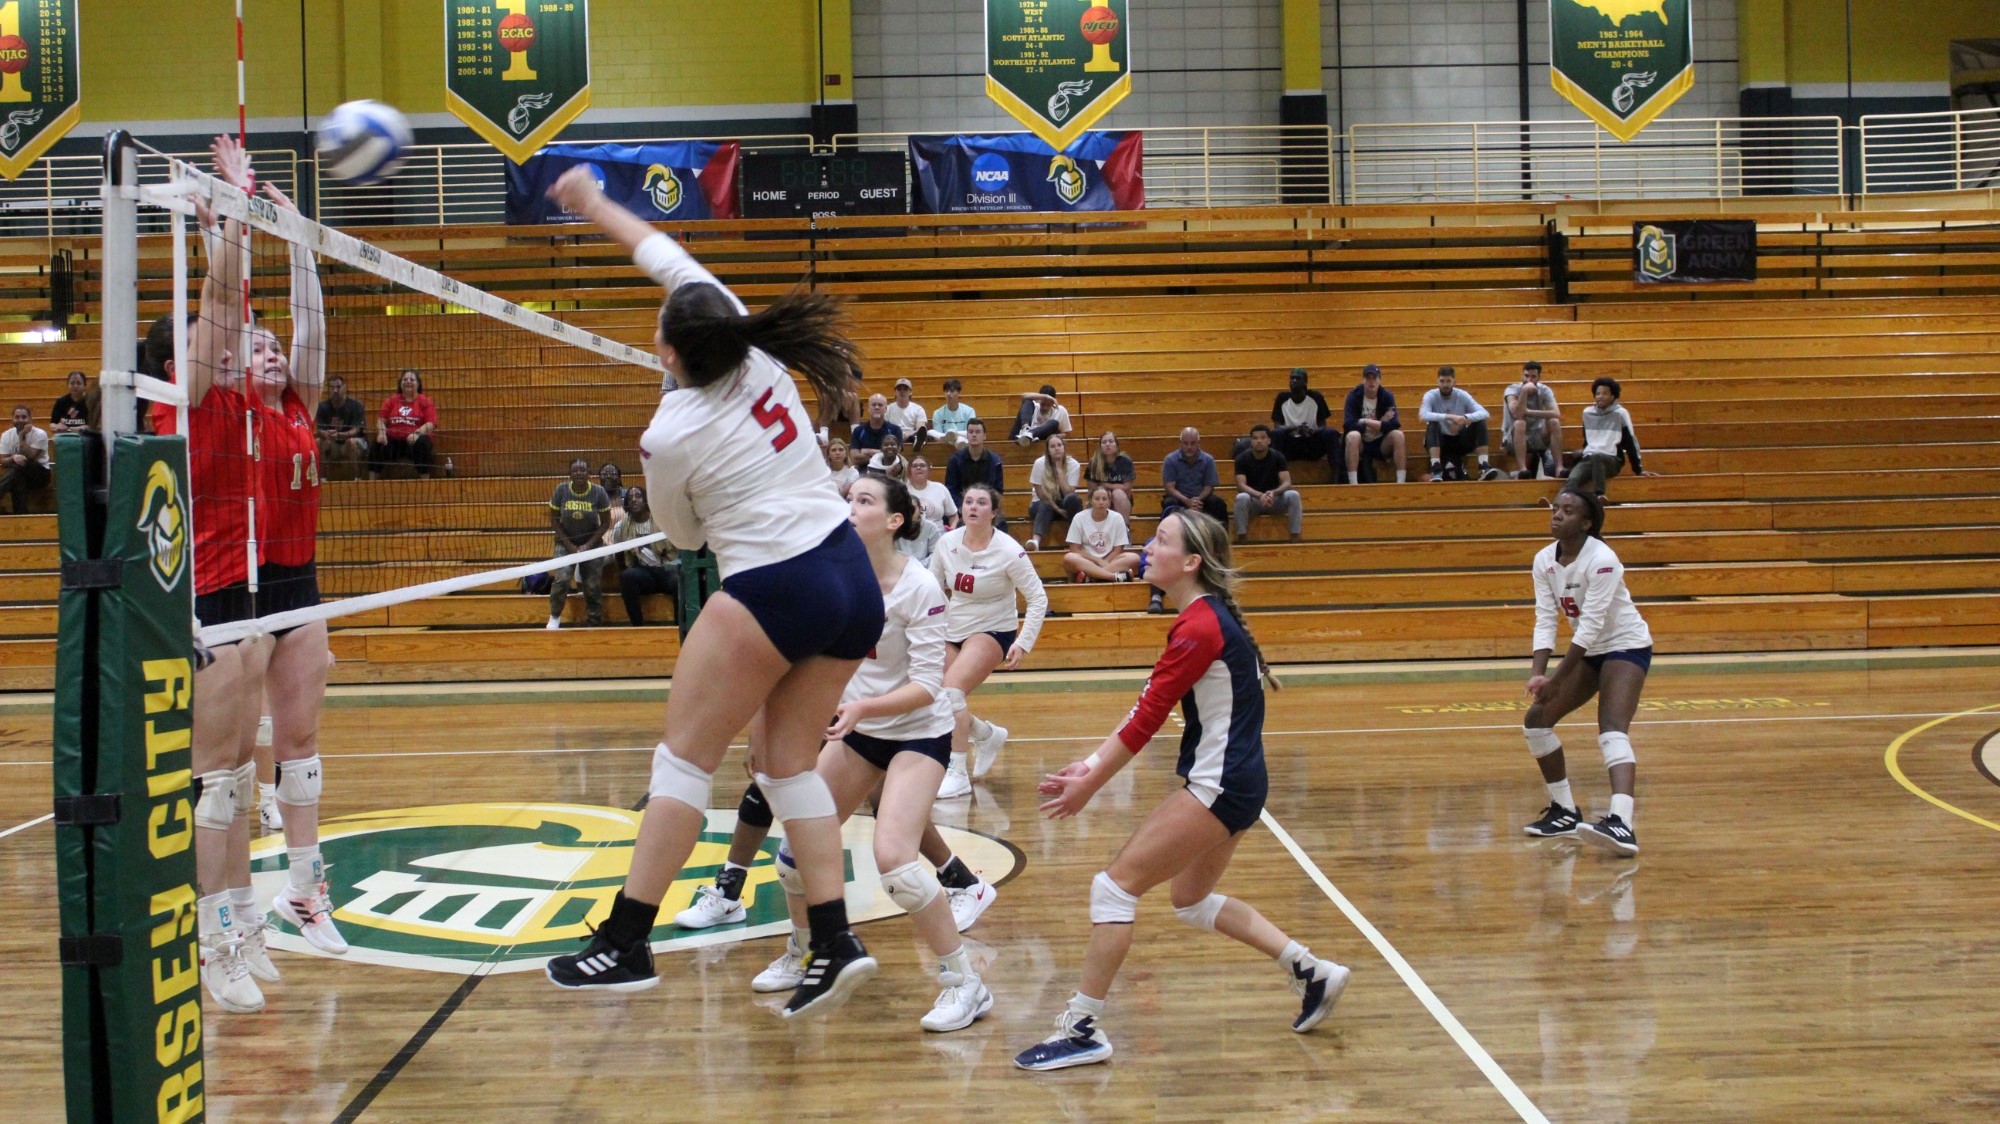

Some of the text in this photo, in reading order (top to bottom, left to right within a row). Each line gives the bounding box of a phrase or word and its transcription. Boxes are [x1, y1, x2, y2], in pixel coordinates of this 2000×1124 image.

[1082, 20, 1118, 32] NJCU
[501, 28, 533, 39] ECAC
[1608, 40, 1665, 48] BASKETBALL
[0, 50, 27, 62] NJAC
[1594, 50, 1650, 58] CHAMPIONS
[975, 170, 1009, 182] NCAA
[752, 188, 898, 201] HOME PERIOD GUEST
[966, 193, 1006, 204] Division
[1682, 234, 1748, 250] GREEN
[1688, 252, 1745, 268] ARMY
[750, 386, 798, 453] 5
[290, 450, 319, 490] 14
[954, 572, 975, 594] 18
[1560, 596, 1580, 618] 15
[142, 657, 193, 859] CITY
